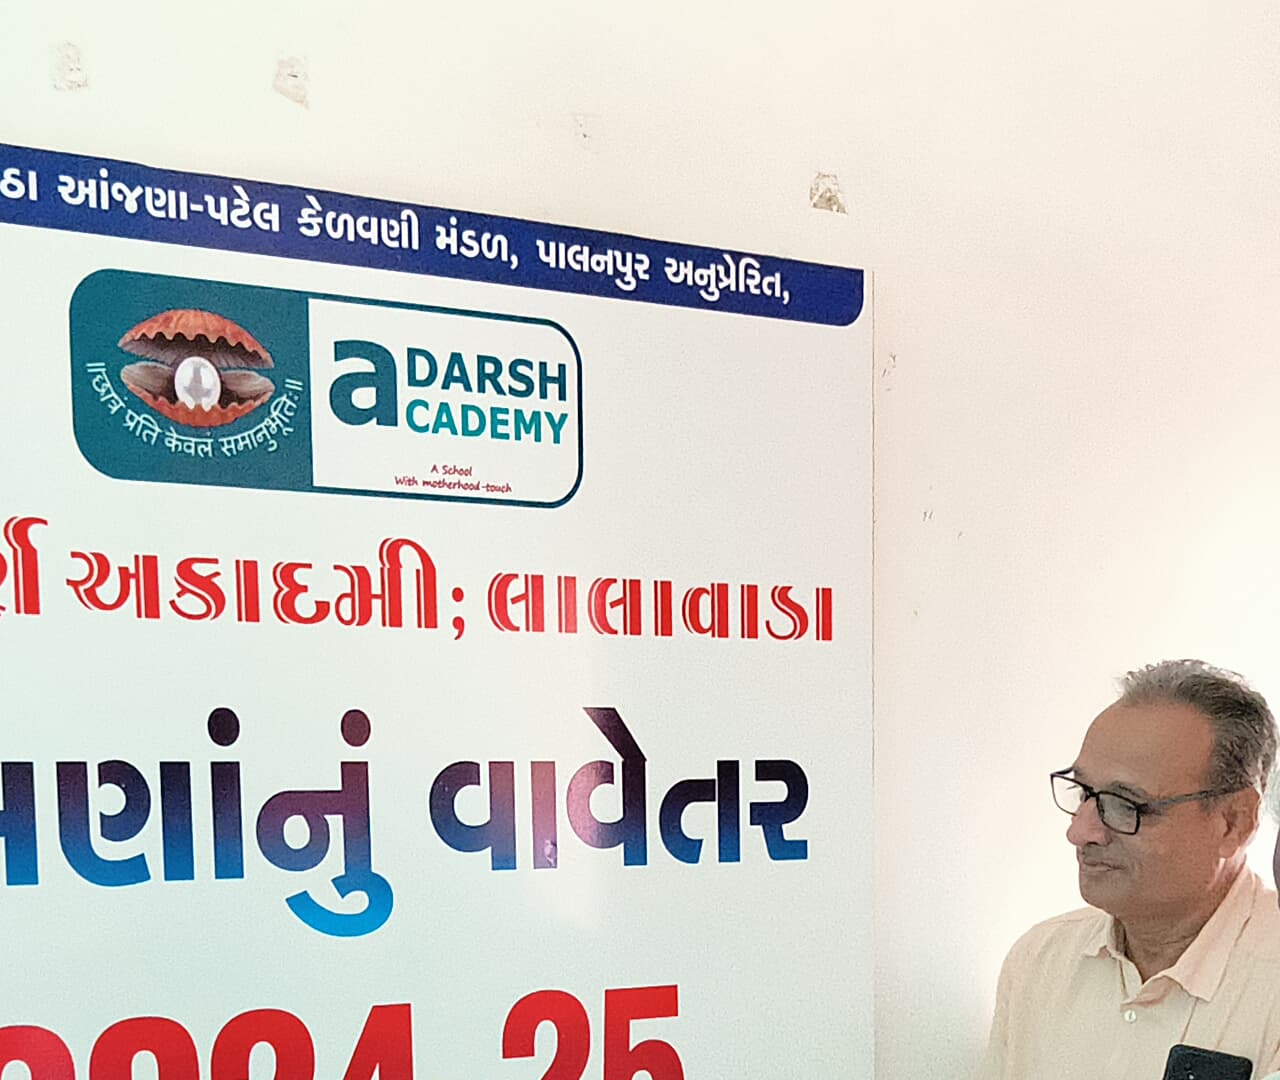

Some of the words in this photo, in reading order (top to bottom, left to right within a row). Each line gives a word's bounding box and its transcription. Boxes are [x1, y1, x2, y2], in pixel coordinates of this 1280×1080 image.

[57, 166, 280, 233] આંજણા-પટેલ
[296, 195, 419, 250] કેળવણી
[434, 217, 520, 269] મંડળ,
[536, 238, 650, 291] પાલનપુર
[663, 255, 791, 304] અનુપ્રેરિત,
[394, 475, 418, 487] With
[430, 464, 439, 474] A
[442, 464, 473, 477] School
[487, 571, 833, 642] લાલાવાડા
[429, 706, 810, 874] વાવેતર
